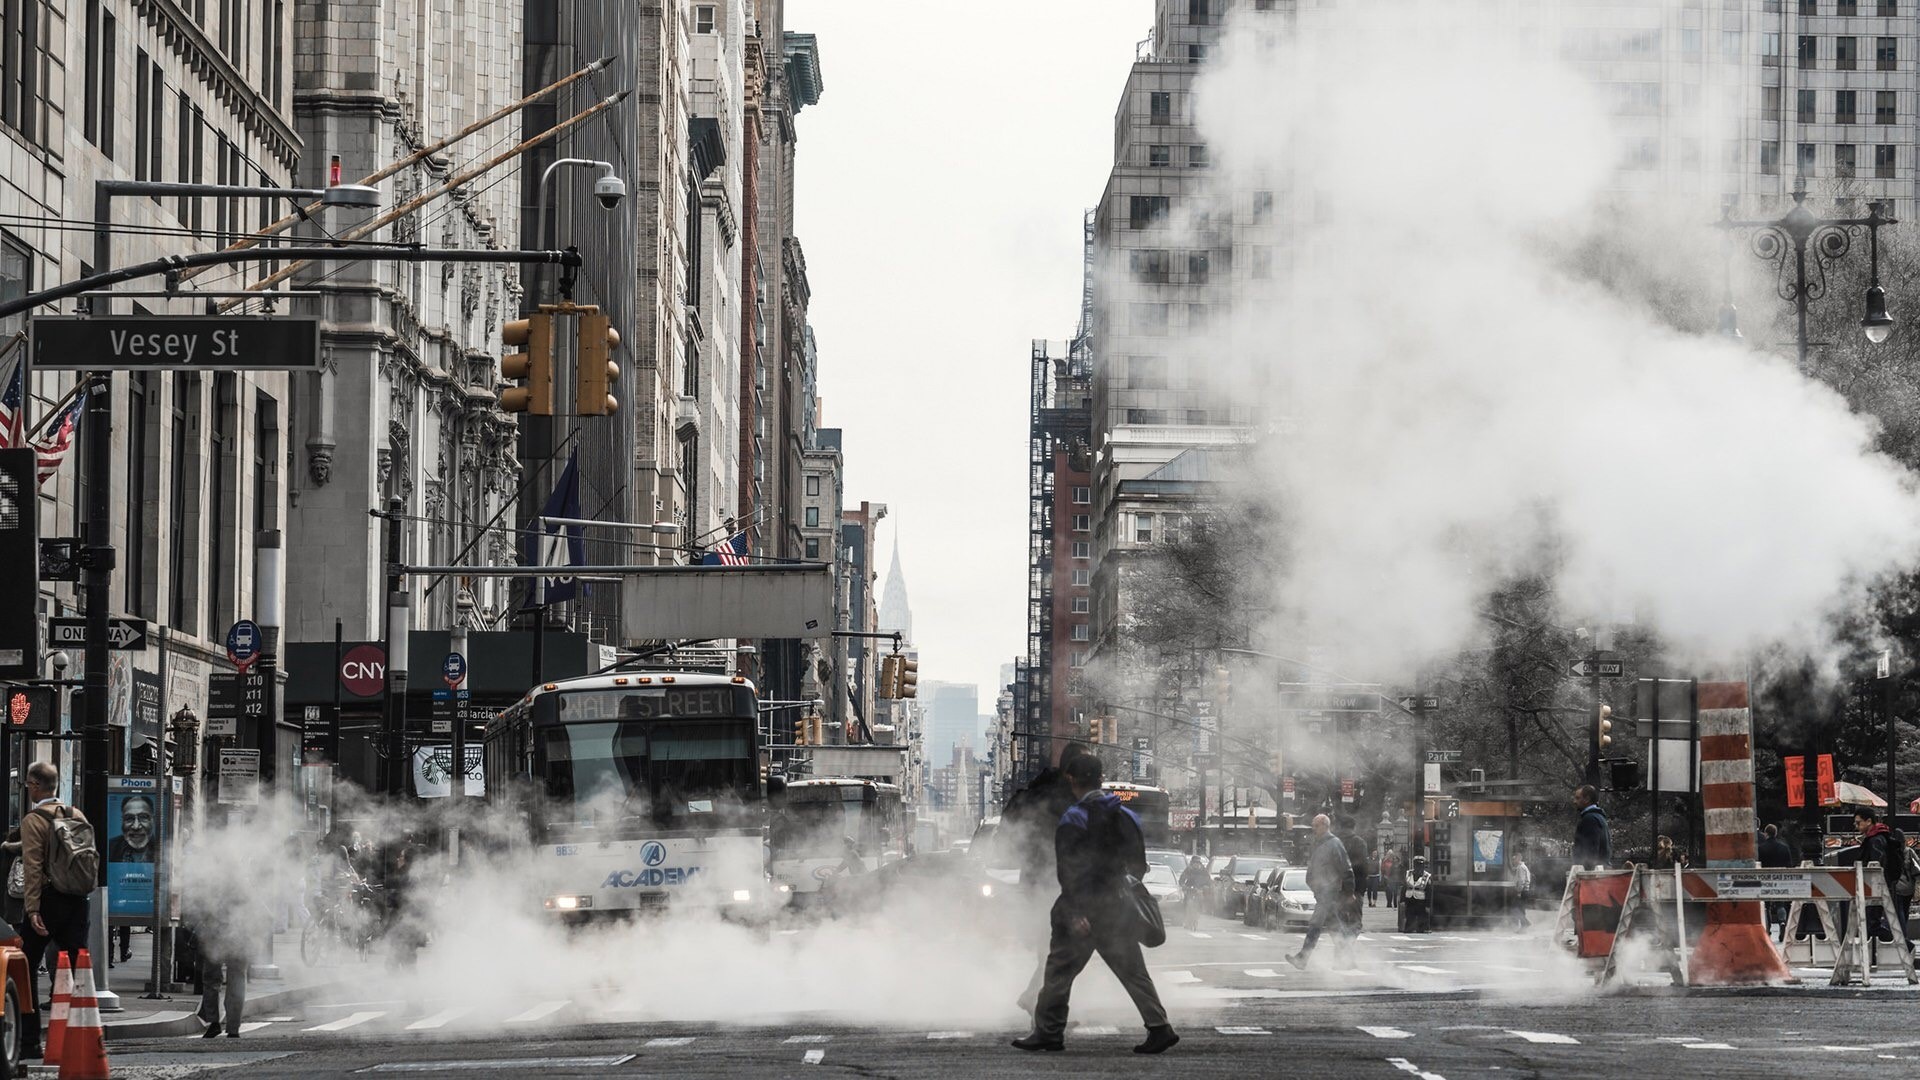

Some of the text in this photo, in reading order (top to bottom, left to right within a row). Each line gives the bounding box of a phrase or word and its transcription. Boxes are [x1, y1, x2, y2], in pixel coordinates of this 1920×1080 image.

[110, 329, 239, 363] Vesey St
[246, 675, 263, 686] x10
[246, 690, 262, 700] x11
[638, 690, 727, 718] STREET
[1332, 696, 1357, 707] Row
[245, 703, 262, 714] x12
[1428, 752, 1449, 762] Park
[121, 777, 152, 788] Phone
